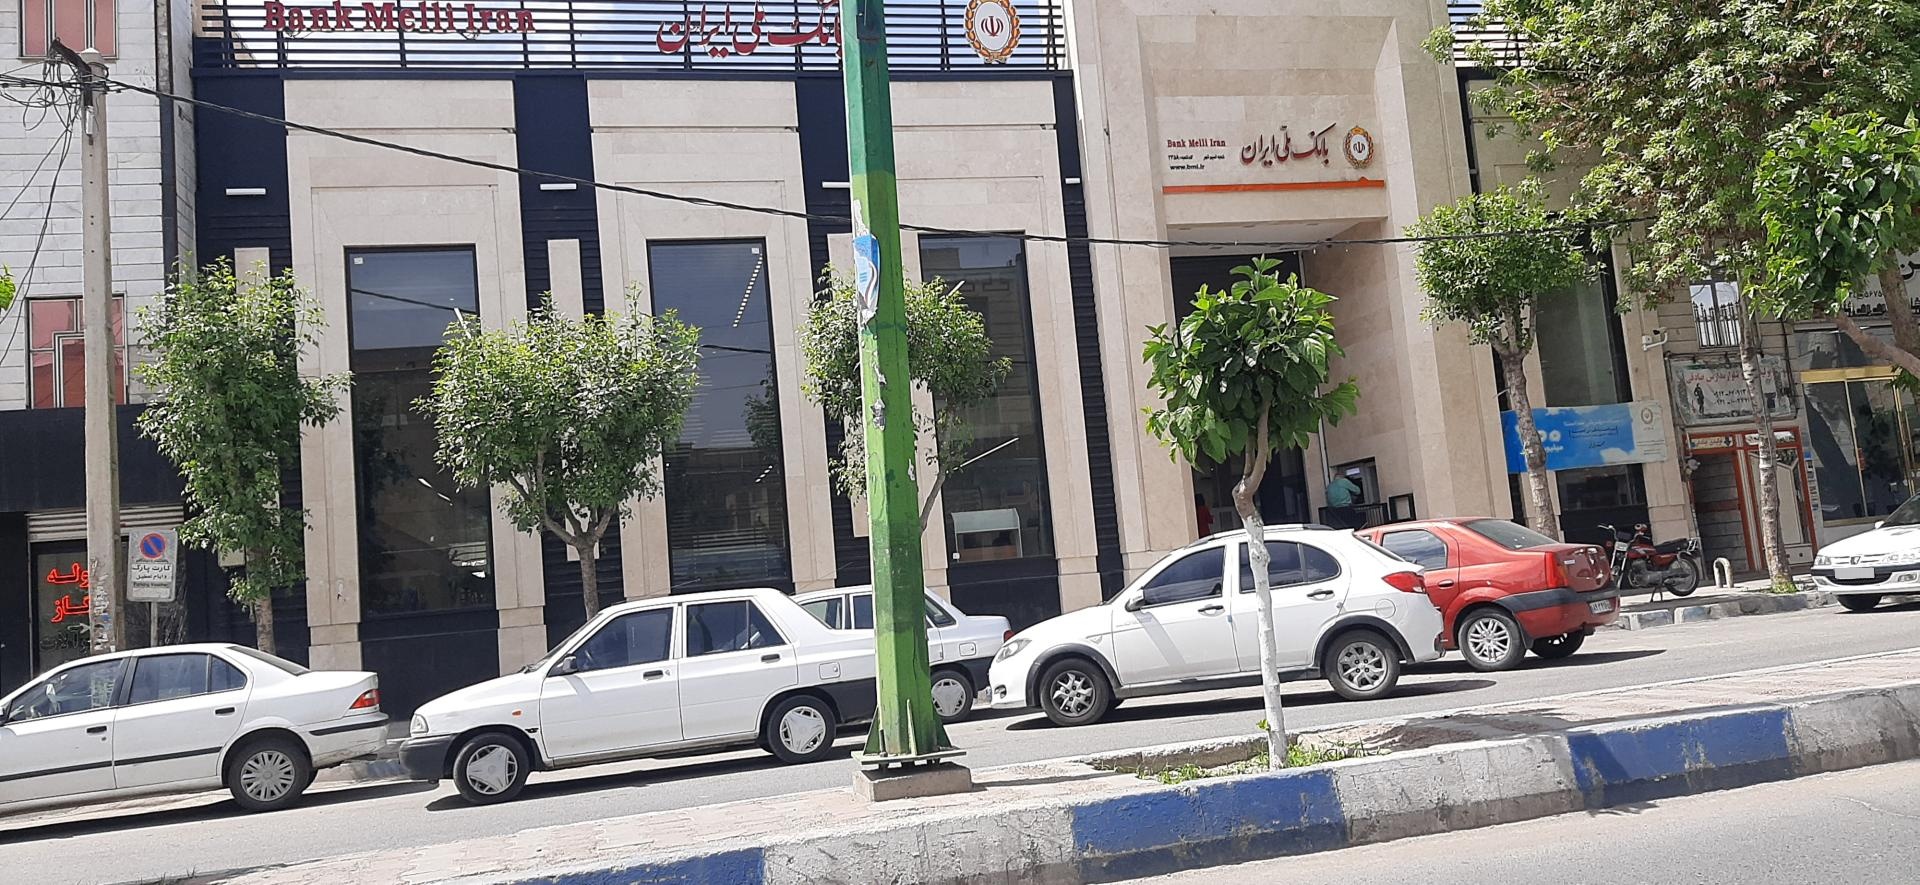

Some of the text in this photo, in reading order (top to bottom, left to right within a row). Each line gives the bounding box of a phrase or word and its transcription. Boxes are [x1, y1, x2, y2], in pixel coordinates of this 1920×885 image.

[264, 1, 537, 34] Bank Melli Iran
[656, 3, 730, 58] ایران
[1167, 138, 1226, 148] Bank Melli Iran
[1241, 133, 1275, 167] ایران
[1292, 122, 1337, 166] بانک
[131, 564, 170, 574] کارت پارک
